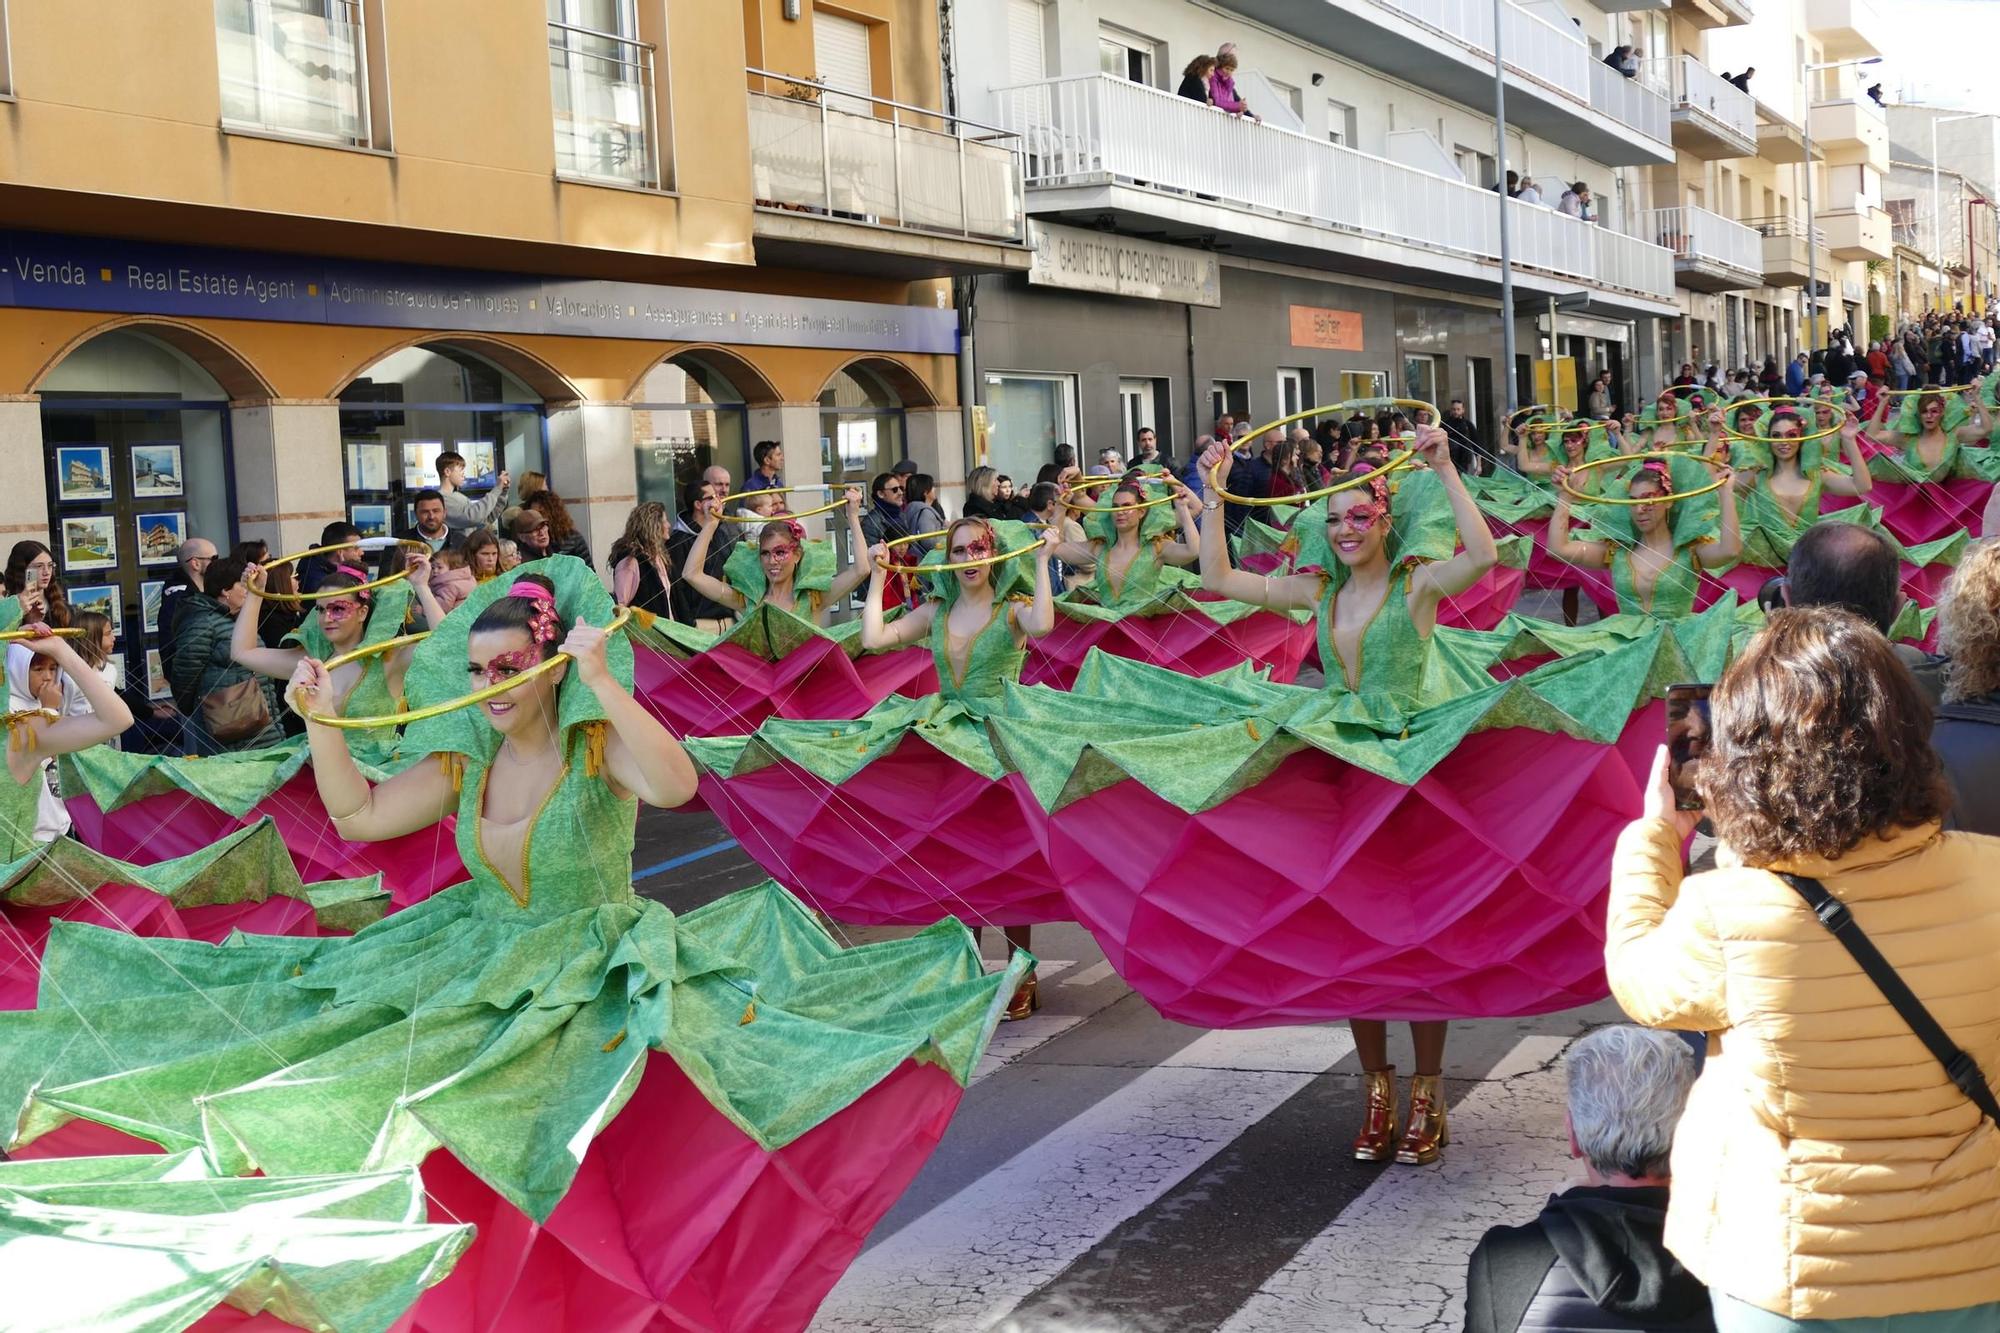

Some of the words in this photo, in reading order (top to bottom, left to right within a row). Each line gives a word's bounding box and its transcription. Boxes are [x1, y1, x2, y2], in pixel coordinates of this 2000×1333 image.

[16, 256, 86, 285] Venda
[127, 264, 172, 291] Real
[178, 268, 238, 295] Estate
[244, 274, 296, 303] Agent
[546, 296, 621, 320] Valoracions
